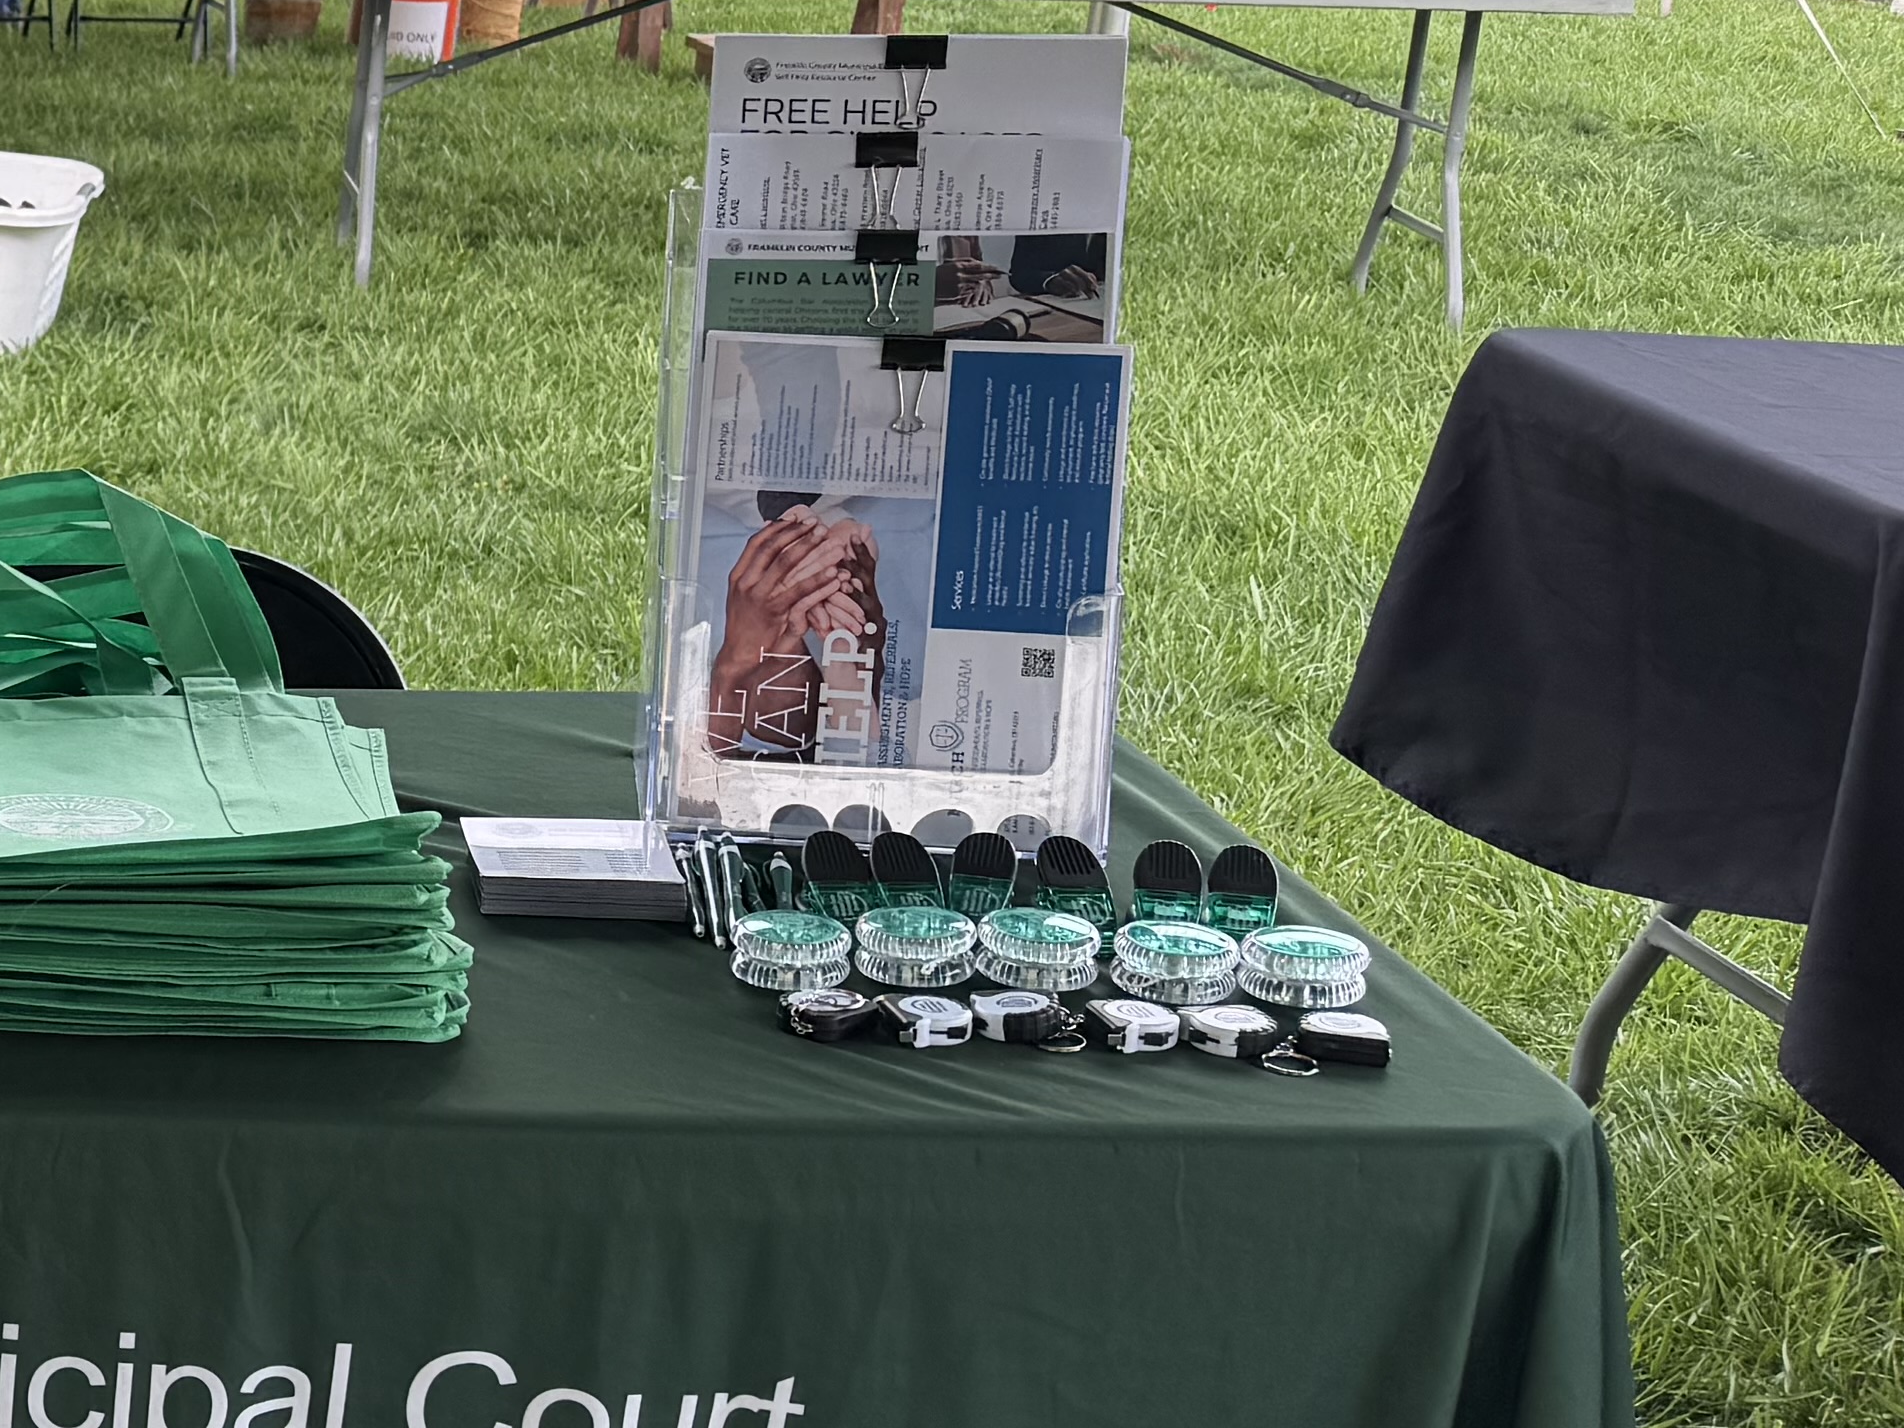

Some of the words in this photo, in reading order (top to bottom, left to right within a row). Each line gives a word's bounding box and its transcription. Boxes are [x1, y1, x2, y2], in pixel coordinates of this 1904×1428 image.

[742, 98, 831, 124] FREE
[843, 99, 937, 125] HELP
[721, 148, 730, 166] VET
[748, 244, 795, 252] FRANKLIN
[735, 272, 787, 285] FIND
[797, 273, 811, 285] A
[715, 422, 730, 481] Partnerships
[951, 571, 964, 610] Services
[899, 658, 911, 690] HOPE
[955, 659, 971, 723] PROGRAM
